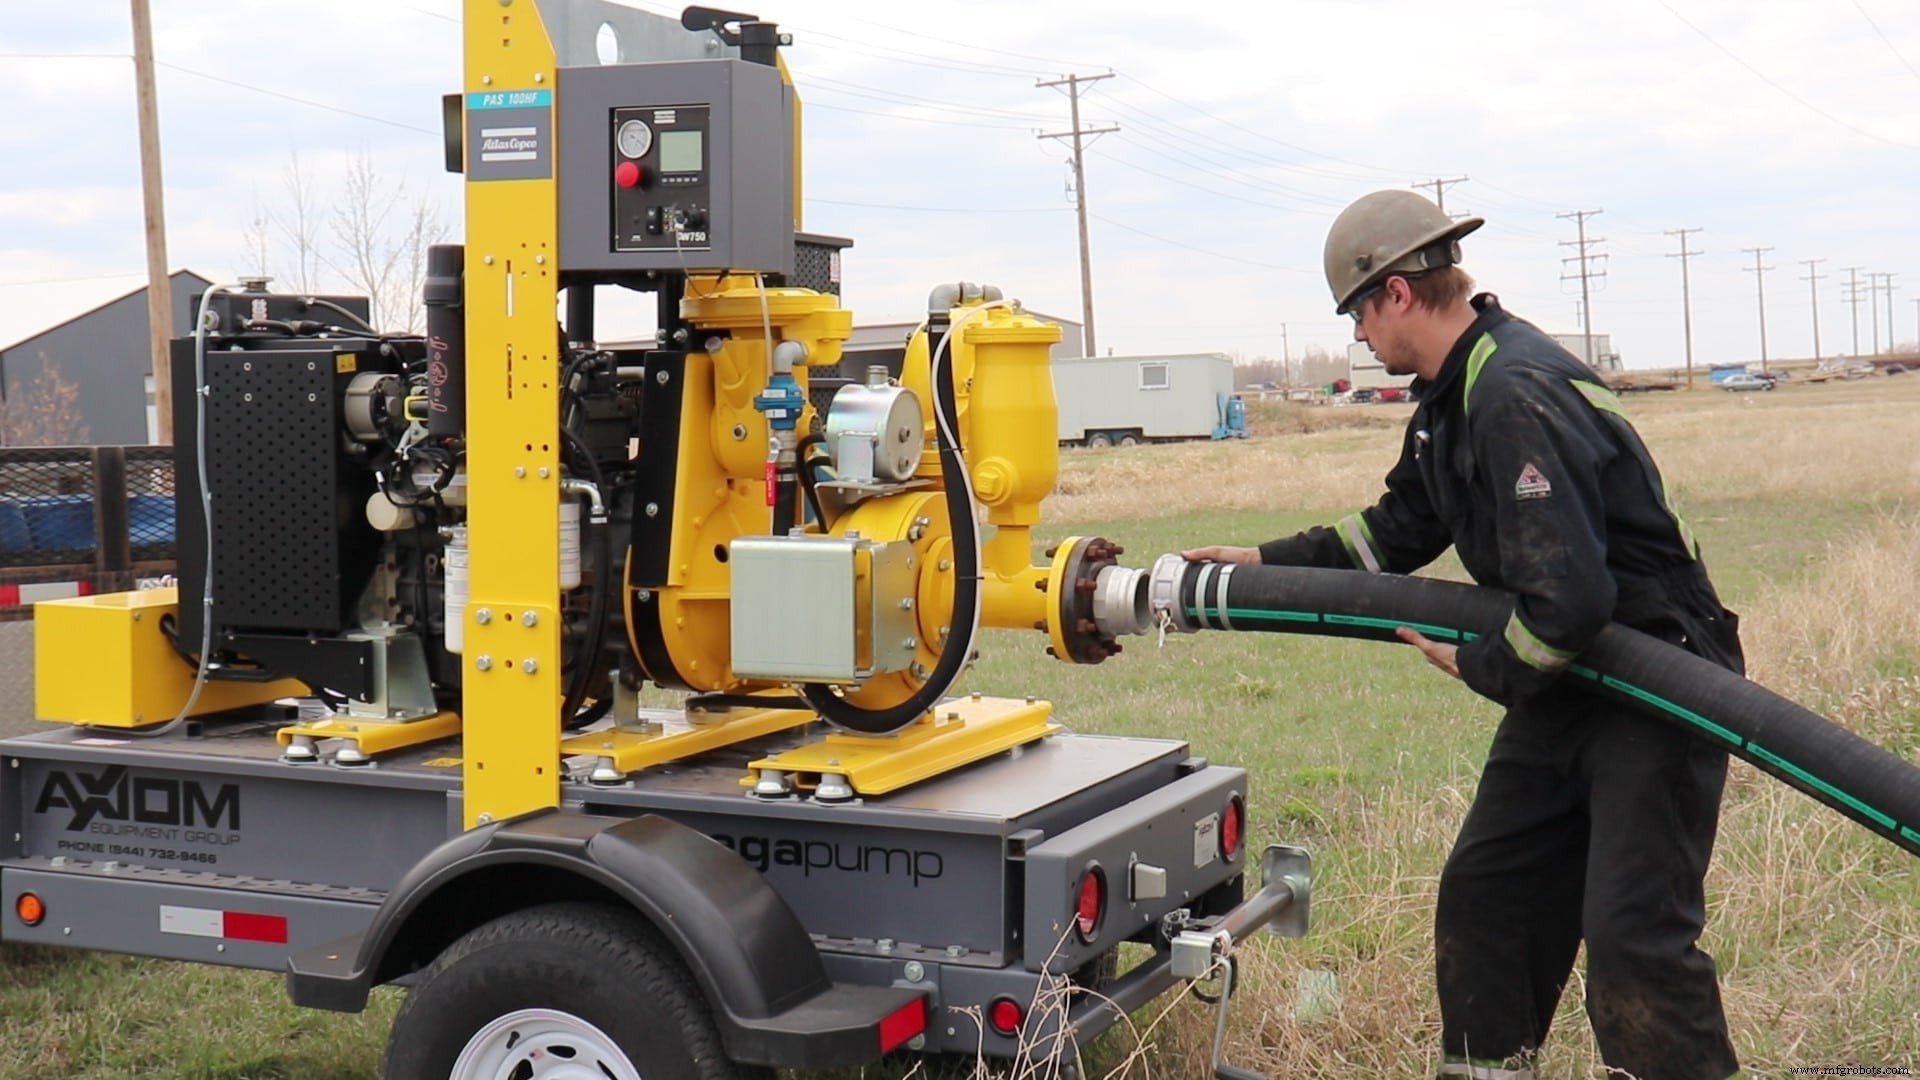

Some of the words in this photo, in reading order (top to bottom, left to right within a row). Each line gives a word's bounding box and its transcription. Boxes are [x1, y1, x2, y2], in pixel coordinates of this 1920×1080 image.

[483, 94, 504, 106] PAS
[508, 92, 539, 105] 100HF
[35, 764, 240, 831] AXIOM
[90, 822, 180, 841] EQUIPMENT
[184, 830, 241, 846] GROUP
[57, 840, 104, 854] PHONE
[108, 844, 145, 857] (844)
